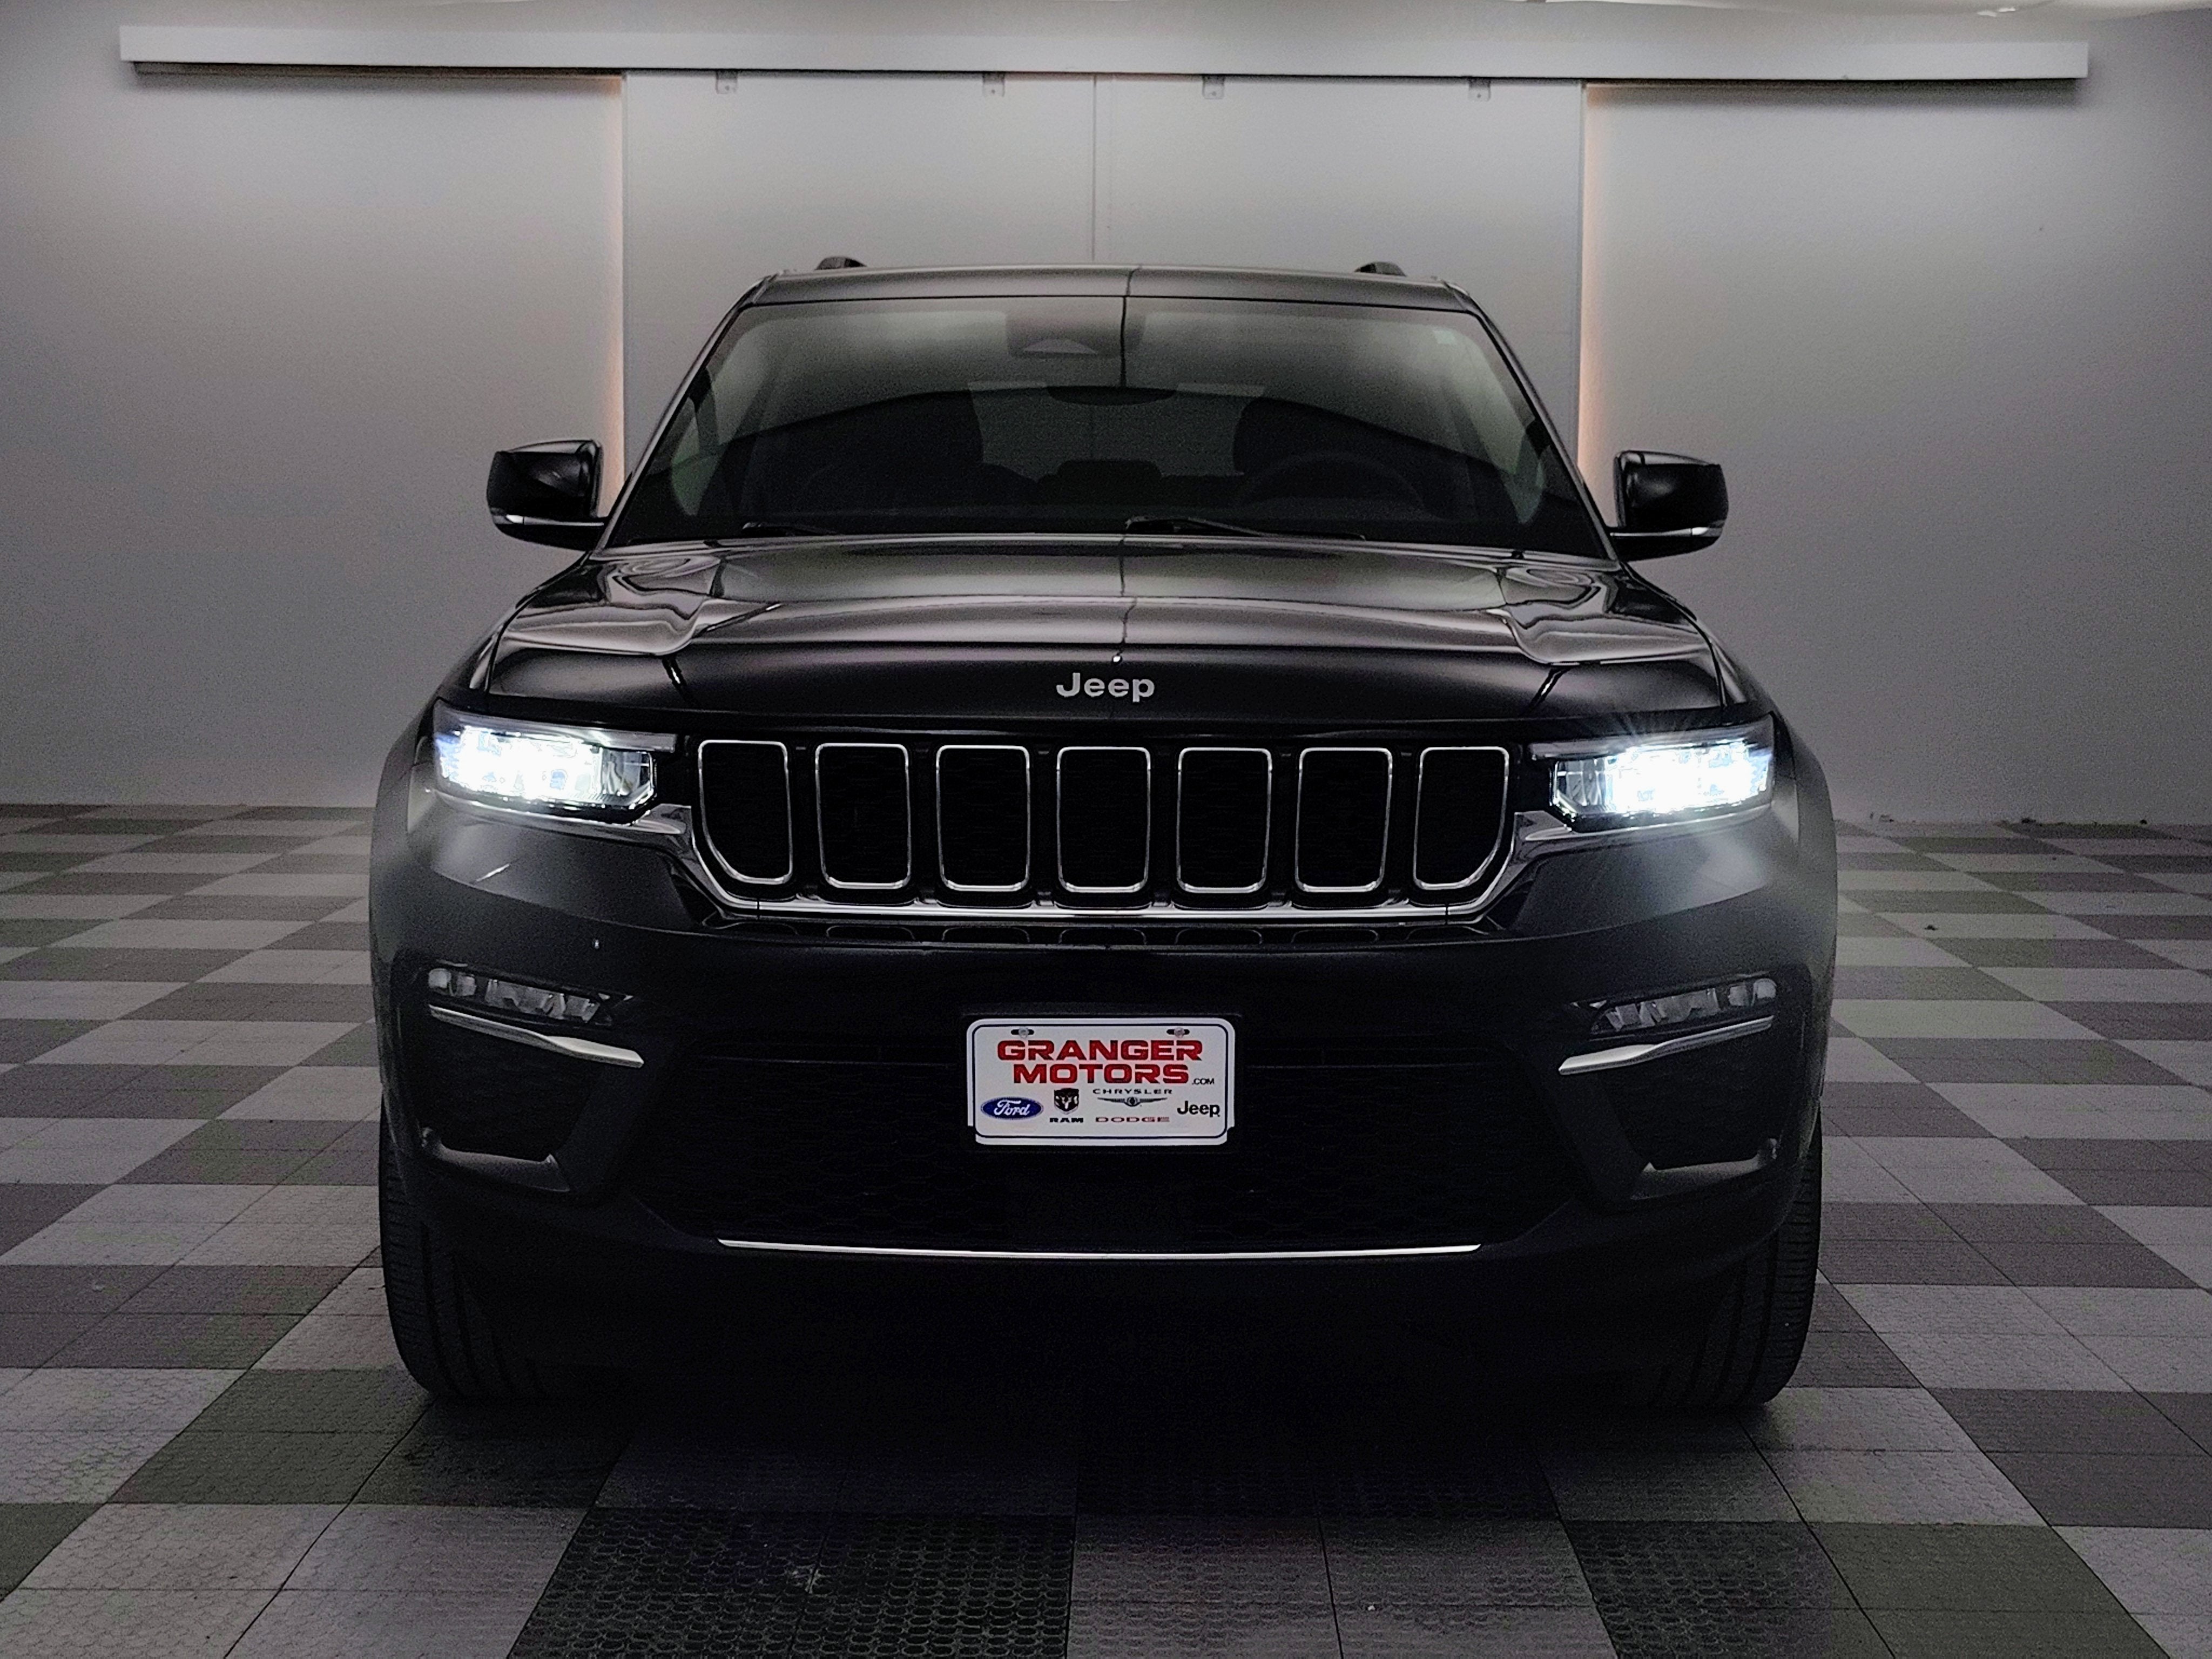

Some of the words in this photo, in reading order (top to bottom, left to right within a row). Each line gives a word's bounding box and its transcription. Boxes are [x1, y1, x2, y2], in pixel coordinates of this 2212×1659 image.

[1056, 672, 1155, 703] Jeep
[997, 1040, 1203, 1061] GRANGER
[1013, 1063, 1190, 1084] MOTORS
[994, 1100, 1031, 1116] Ford
[1177, 1101, 1220, 1117] Jeep
